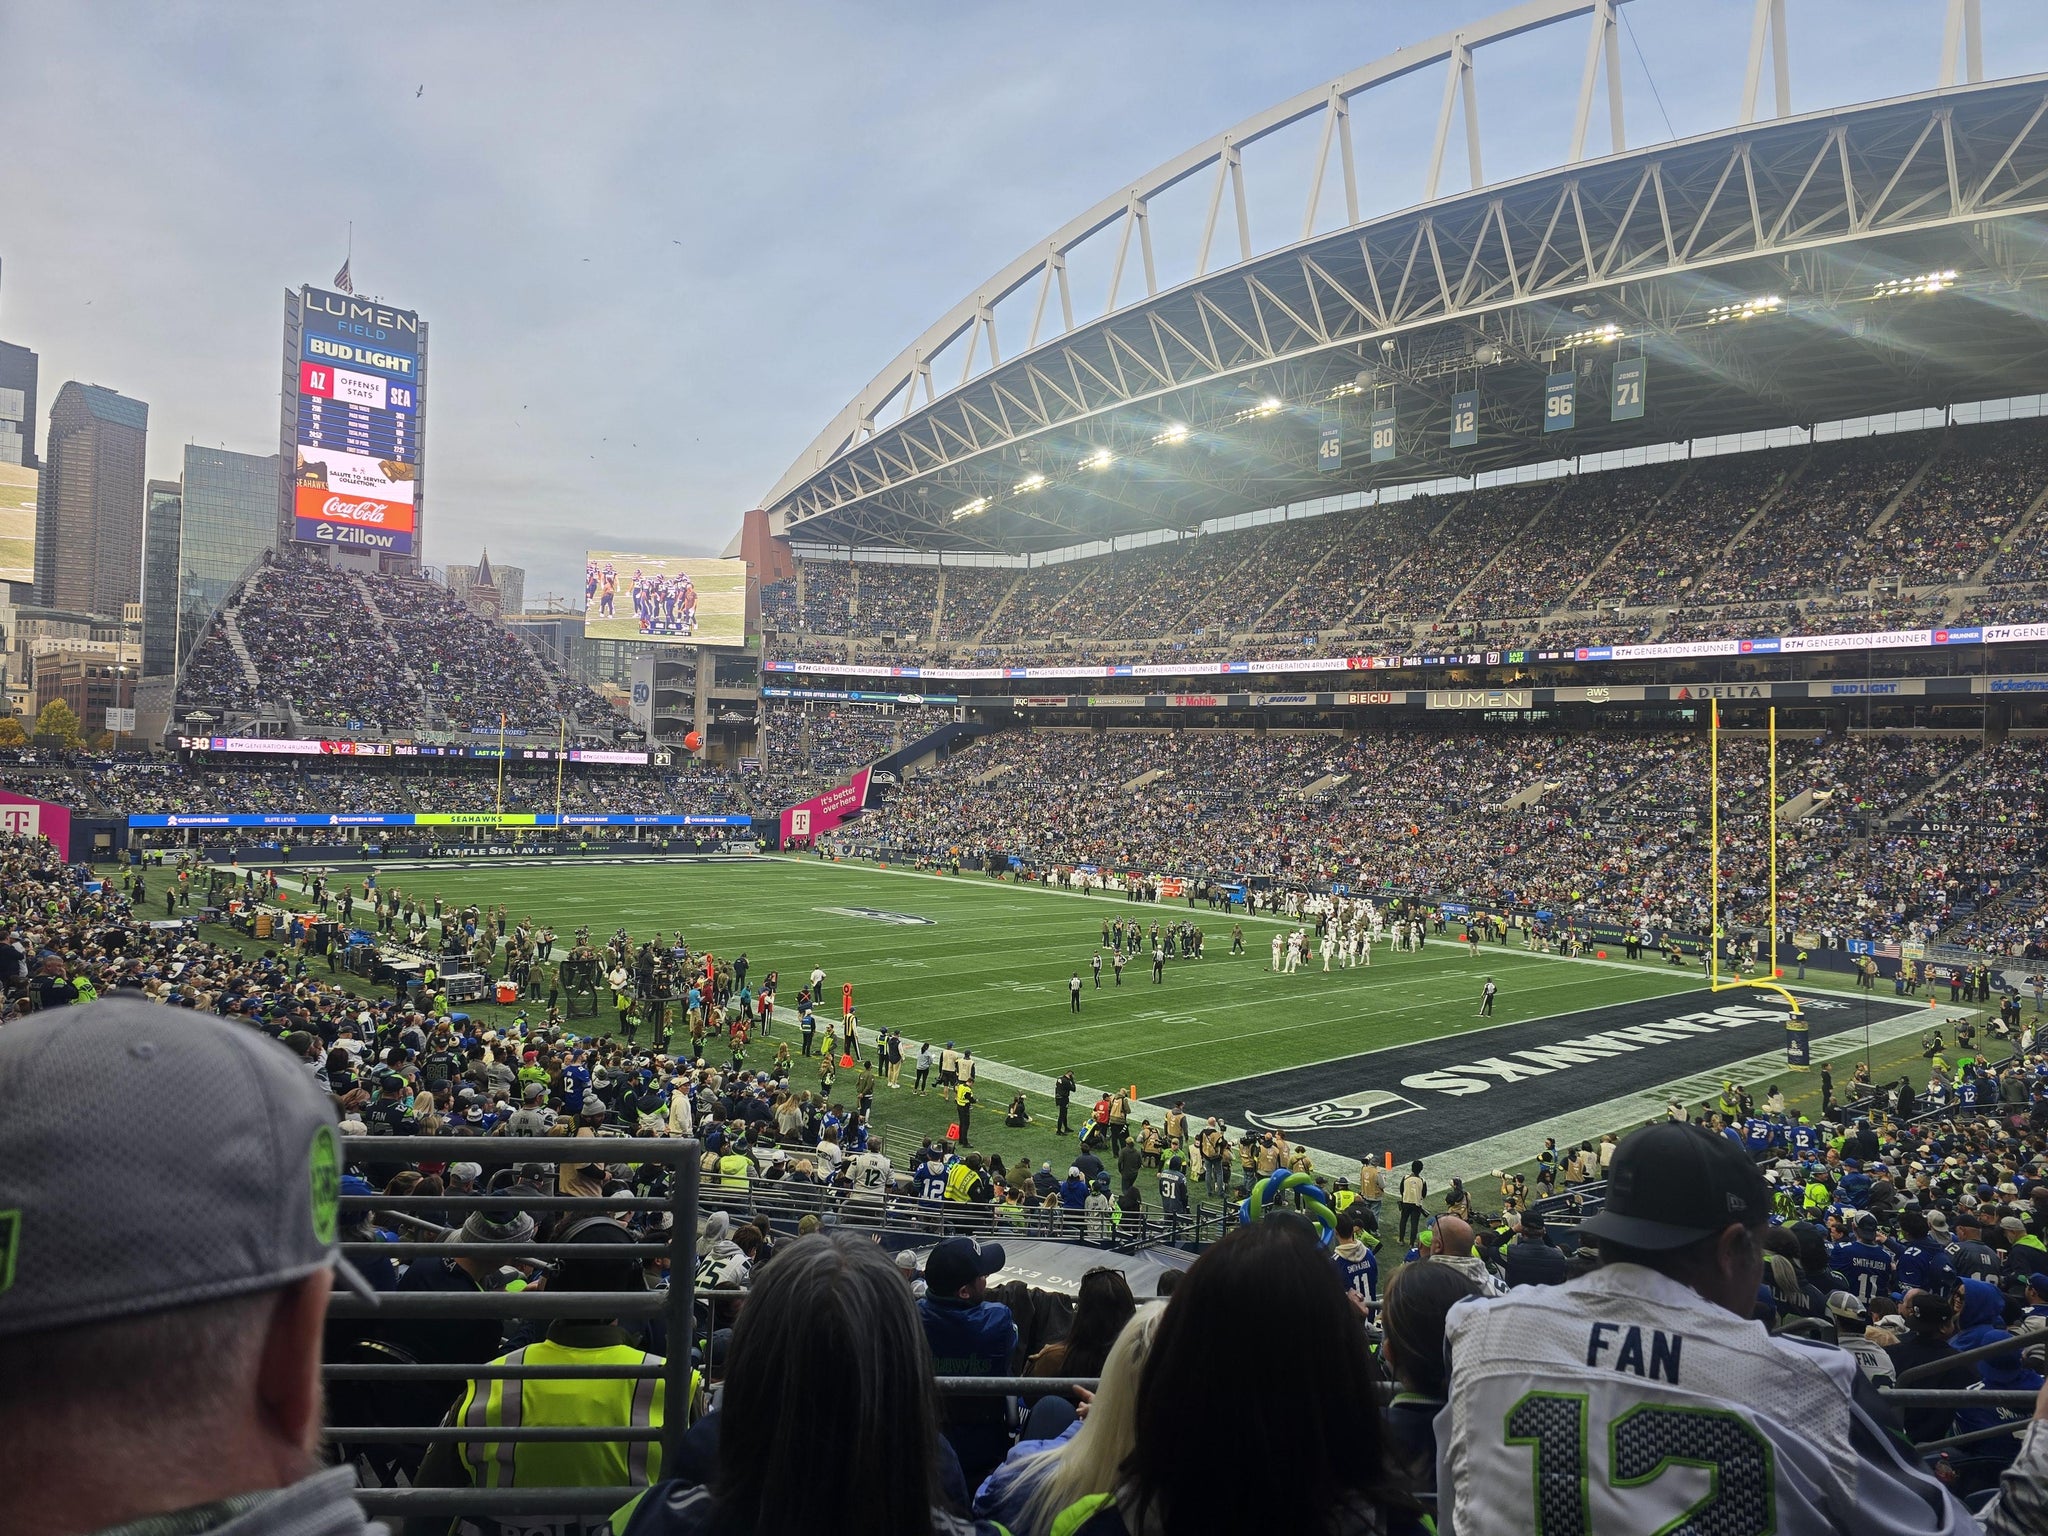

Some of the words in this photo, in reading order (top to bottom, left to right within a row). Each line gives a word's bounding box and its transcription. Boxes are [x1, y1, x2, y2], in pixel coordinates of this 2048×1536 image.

[306, 292, 416, 333] LUMEN
[338, 321, 386, 340] FIELD
[310, 338, 353, 360] BUD
[355, 348, 411, 373] LIGHT
[310, 371, 325, 390] AZ
[341, 378, 379, 391] OFFENSE
[347, 388, 373, 399] STATS
[391, 388, 410, 407] SEA
[1617, 382, 1639, 406] 71
[1548, 394, 1572, 417] 96
[1455, 412, 1473, 433] 12
[1373, 428, 1393, 449] 80
[1319, 439, 1339, 458] 45
[337, 526, 393, 548] Zillow
[1949, 631, 1979, 639] 4RUNNER
[1987, 629, 2010, 638] 6TH
[2014, 627, 2048, 637] GENE
[1785, 639, 1804, 648] 6TH
[1806, 636, 1873, 648] GENERATION
[1876, 633, 1927, 645] 4RUNNER
[1615, 648, 1632, 656] 6TH
[1634, 646, 1690, 655] GENERATION
[1692, 643, 1735, 653] 4RUNNER
[1489, 655, 1497, 663] 27
[633, 684, 650, 703] 50
[1586, 687, 1609, 696] aws
[1700, 686, 1762, 698] DELTA
[1832, 684, 1858, 694] BUD
[1860, 683, 1897, 693] LIGHT
[1016, 698, 1028, 706] EQC
[1269, 695, 1307, 703] BOEING
[1433, 691, 1523, 708] LUMEN
[350, 722, 360, 730] 12
[178, 737, 210, 750] 7:30
[244, 742, 286, 750] GENERATION
[287, 744, 318, 752] 4RUNNER
[341, 743, 350, 753] 22
[377, 745, 385, 753] 41
[459, 748, 463, 756] 4
[833, 787, 856, 800] better
[821, 797, 833, 806] It's
[840, 795, 856, 806] here
[823, 803, 839, 813] over
[429, 847, 486, 856] SATTLE
[1854, 943, 1867, 953] 12
[1401, 1004, 1791, 1097] SEAHAWKS
[427, 1063, 448, 1080] 80
[563, 1077, 574, 1093] 12
[1964, 1091, 1975, 1102] 12
[371, 1111, 387, 1121] FAN
[1752, 1127, 1768, 1139] 27
[1796, 1134, 1809, 1147] 12
[865, 1169, 882, 1186] 12
[637, 1183, 651, 1197] 11
[918, 1178, 945, 1200] 12
[1162, 1180, 1176, 1199] 31
[1904, 1247, 1922, 1257] 27
[1945, 1242, 1961, 1255] 12
[695, 1260, 727, 1289] 25
[1353, 1272, 1372, 1302] 11
[1857, 1273, 1878, 1303] 11
[1587, 1321, 1683, 1386] FAN
[1855, 1352, 1878, 1367] FAN
[1504, 1390, 1777, 1536] 12
